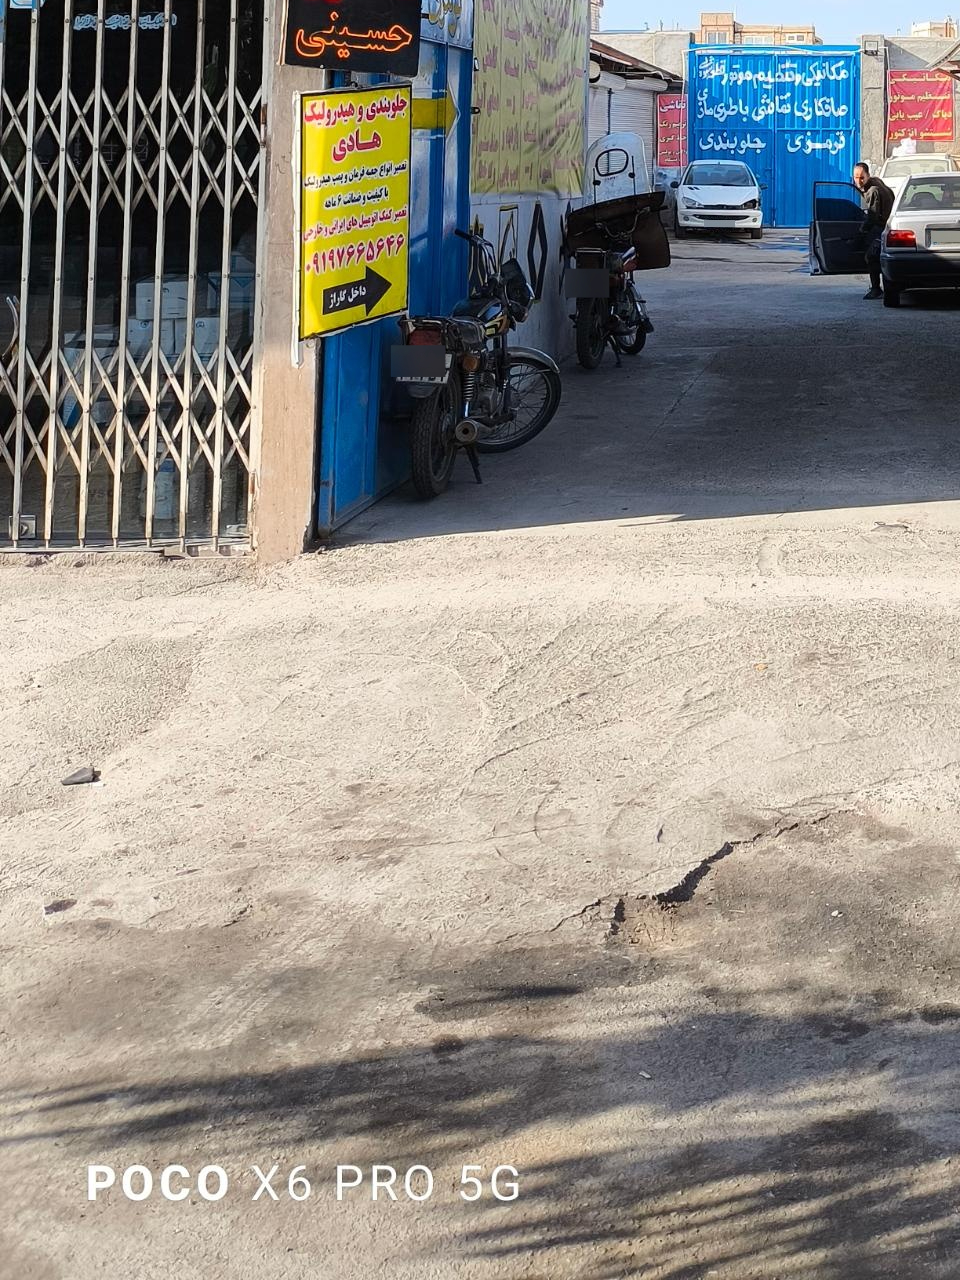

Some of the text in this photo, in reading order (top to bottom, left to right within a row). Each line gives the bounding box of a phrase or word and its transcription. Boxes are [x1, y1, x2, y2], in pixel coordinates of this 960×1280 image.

[295, 10, 414, 59] حسینی
[304, 92, 408, 127] جلوبندی و هیدرولیک
[332, 127, 382, 162] هادی
[700, 130, 767, 155] جلوبندی
[348, 166, 365, 181] فرمان
[379, 163, 393, 177] انواع
[343, 191, 362, 206] ضمانت
[367, 187, 384, 202] کیفیت
[306, 233, 405, 274] ۰۹۱۹۷۶۶۵۶۴۶
[328, 285, 367, 309] داخل گاراژ
